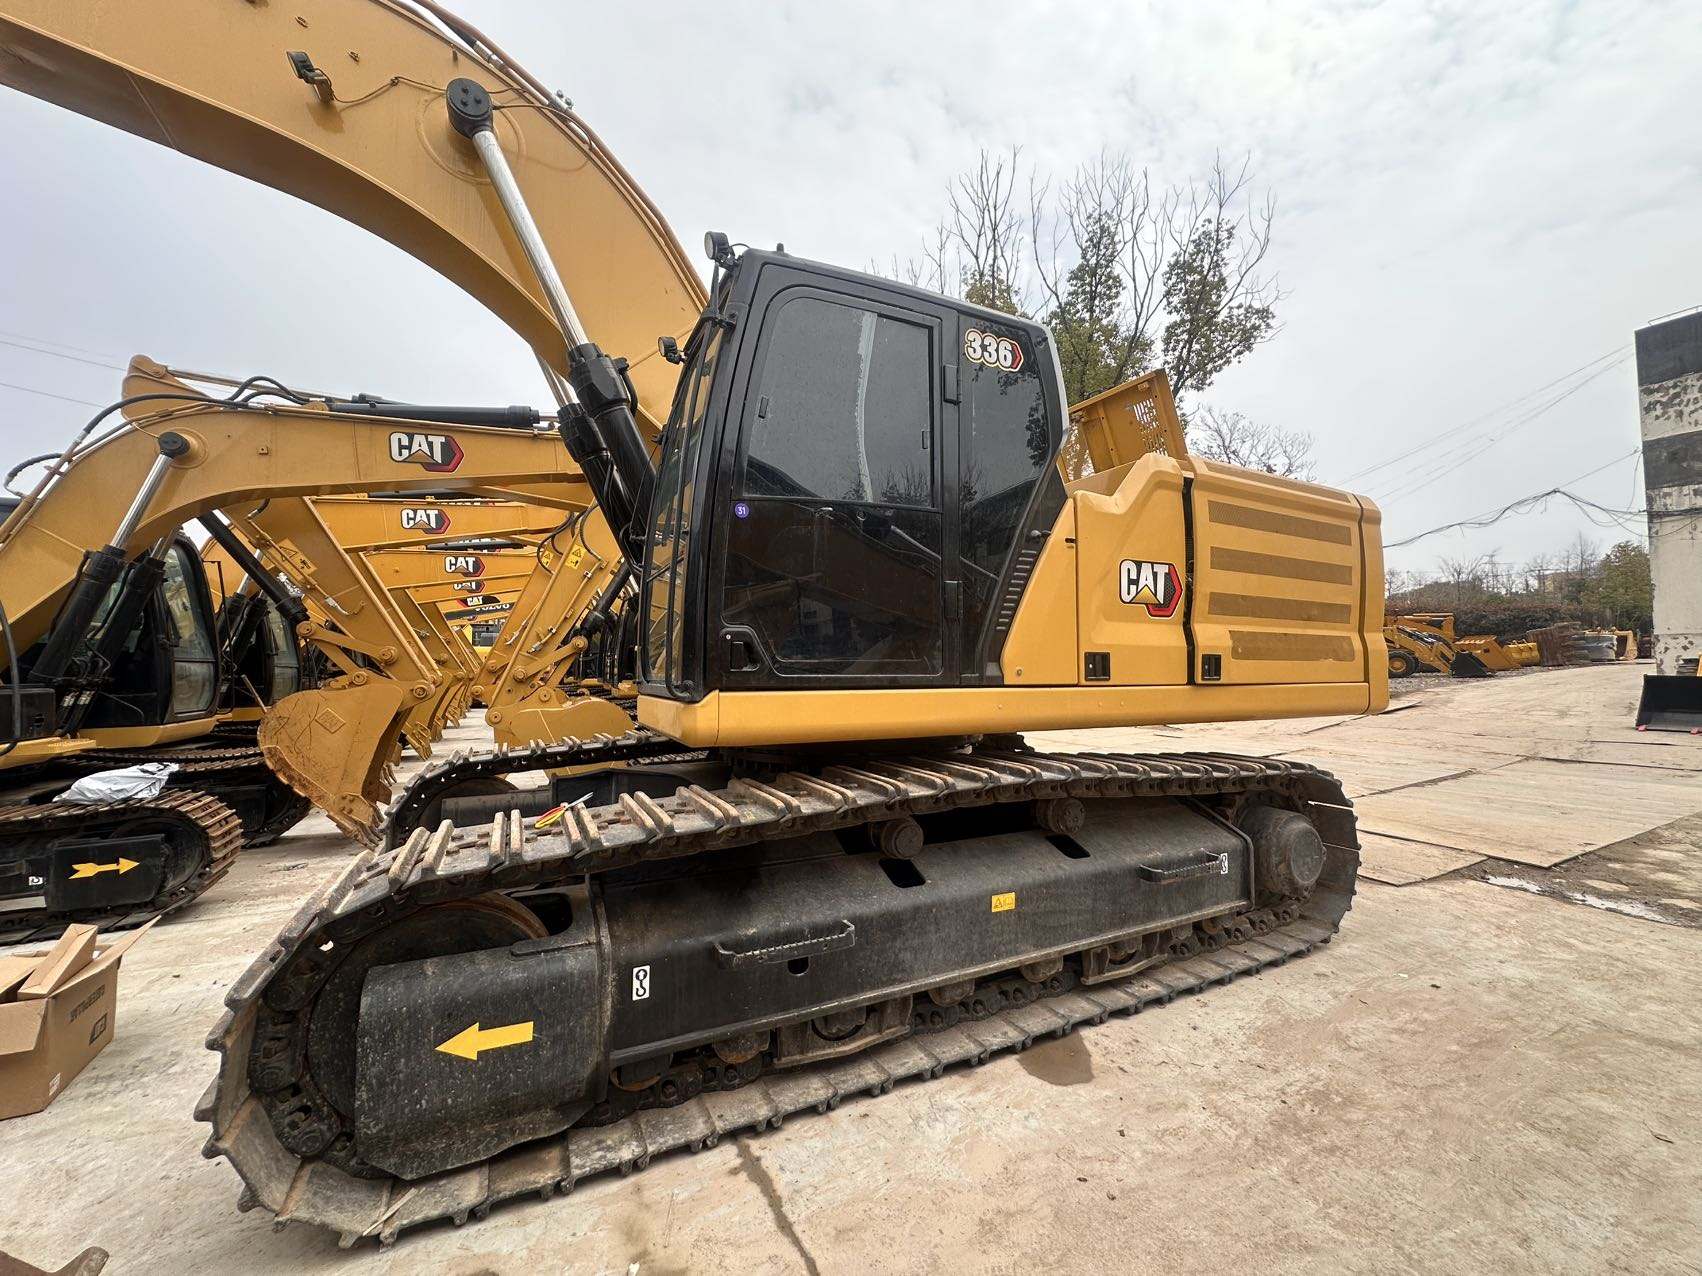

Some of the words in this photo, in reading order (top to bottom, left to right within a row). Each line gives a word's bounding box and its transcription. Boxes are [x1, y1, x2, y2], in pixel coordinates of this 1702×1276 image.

[967, 331, 1012, 367] 336
[391, 433, 445, 463] CAT
[402, 509, 438, 528] CAT
[446, 557, 475, 573] CAT
[1120, 560, 1169, 604] CAT
[467, 596, 483, 606] CAT
